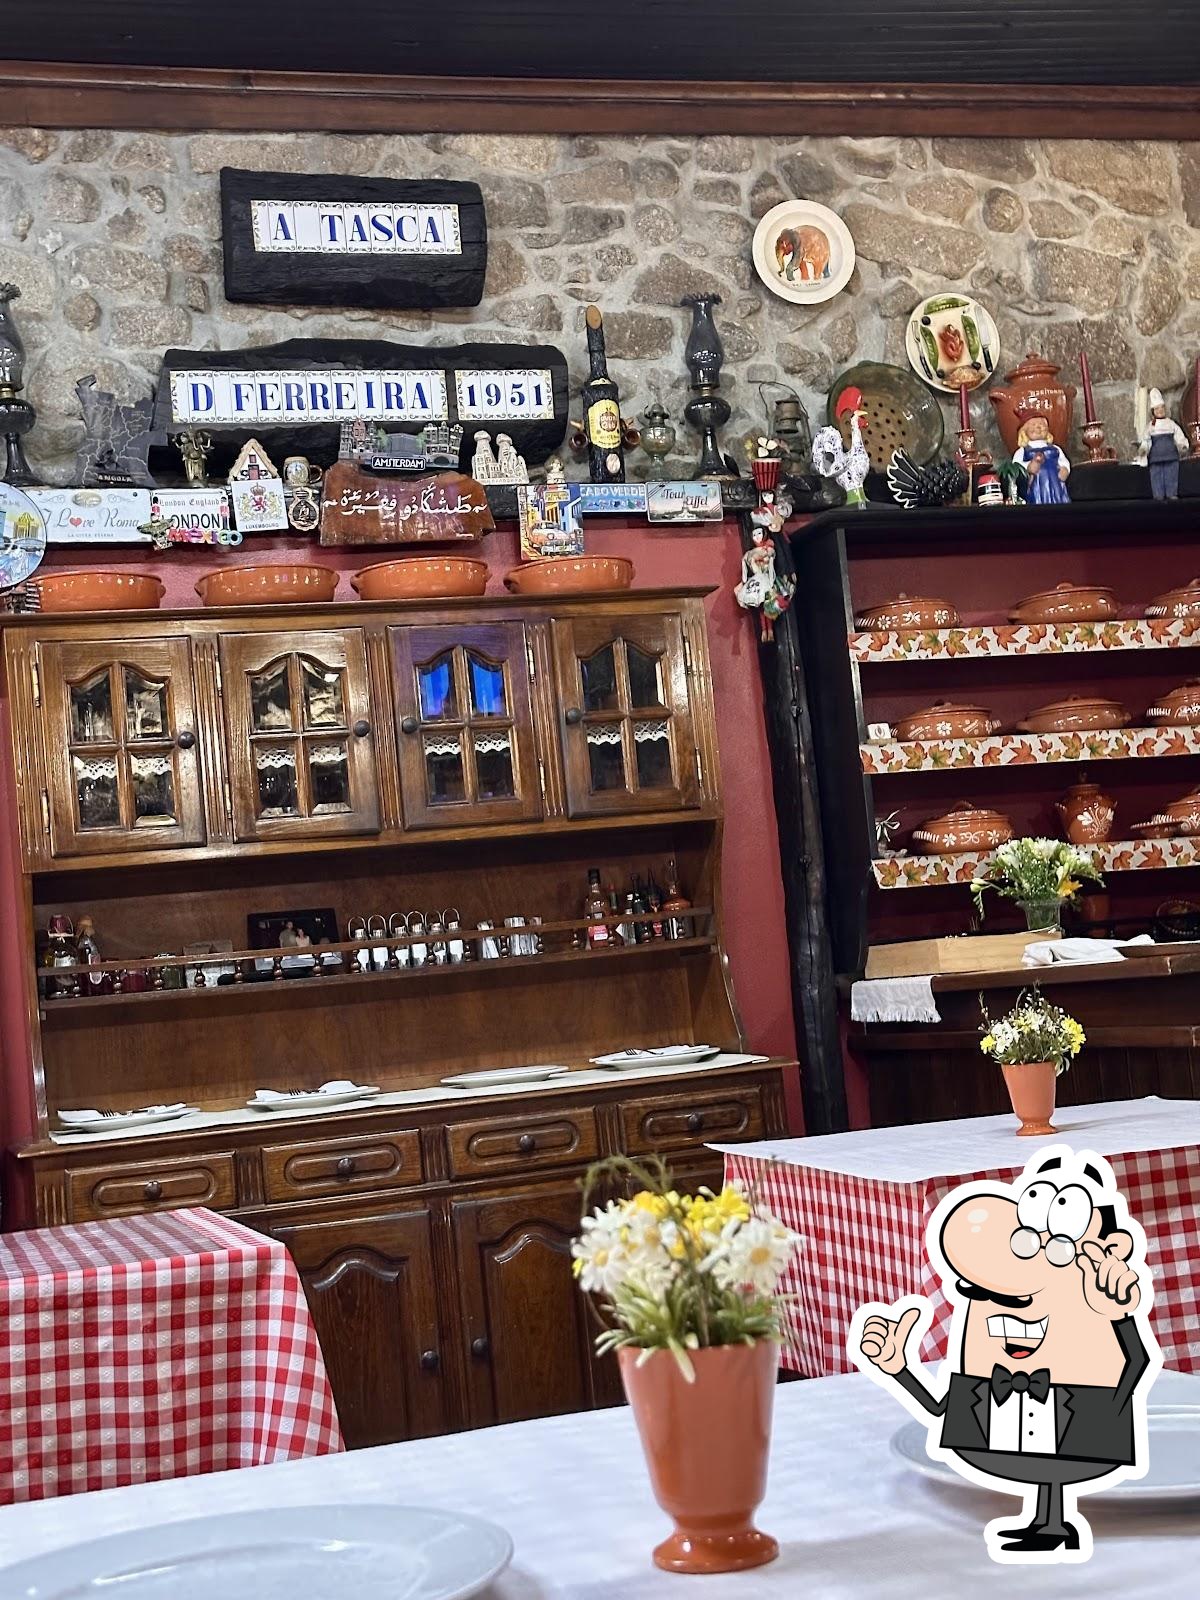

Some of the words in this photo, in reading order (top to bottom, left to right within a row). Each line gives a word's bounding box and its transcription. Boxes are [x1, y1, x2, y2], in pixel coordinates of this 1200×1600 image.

[273, 212, 294, 241] A
[320, 212, 443, 243] TASCA
[190, 382, 214, 412] D
[234, 381, 430, 411] FERREIRA
[467, 381, 544, 407] 1951
[374, 458, 425, 468] AMSTERDAM
[159, 498, 186, 507] London
[189, 498, 220, 507] England
[686, 495, 708, 508] Eiffel
[102, 507, 139, 528] Roma
[161, 513, 221, 529] ONDON
